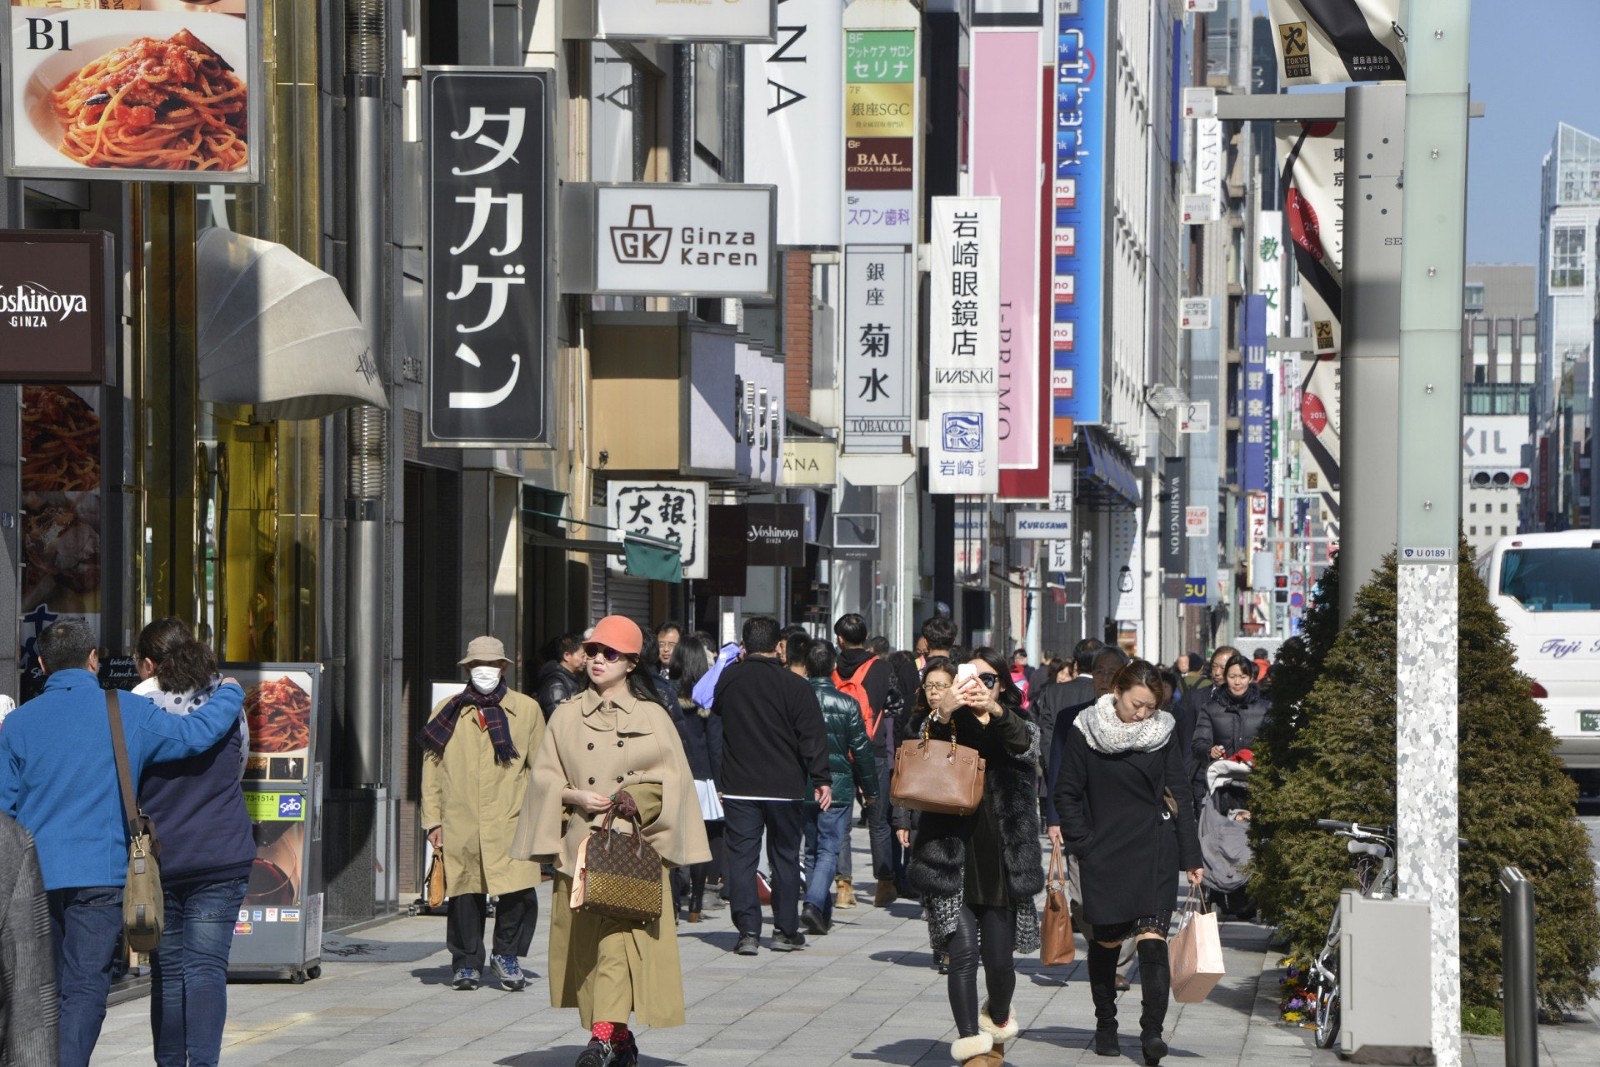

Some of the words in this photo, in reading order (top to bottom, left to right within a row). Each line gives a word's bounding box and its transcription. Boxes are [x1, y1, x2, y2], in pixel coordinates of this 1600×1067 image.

[26, 18, 72, 51] B1
[848, 33, 864, 43] 8F
[766, 0, 807, 117] NA
[848, 46, 887, 58] フットケア
[890, 46, 914, 57] サロン
[1286, 56, 1309, 65] TOKYO
[853, 61, 908, 78] セリナ
[849, 86, 861, 94] 7F
[851, 102, 910, 116] 銀座SGC
[848, 140, 860, 148] 6F
[857, 153, 902, 166] BAAL
[847, 197, 860, 205] 5F
[848, 208, 910, 225] スワン歯科
[682, 227, 755, 245] Ginza
[620, 233, 662, 258] GK
[446, 107, 526, 409] タカゲン
[681, 248, 757, 266] Karen
[866, 262, 885, 306] 銀座
[952, 212, 979, 356] 岩崎眼鏡店
[0, 284, 87, 322] oshinoya
[10, 316, 47, 328] GINZA
[858, 323, 891, 403] 菊水
[852, 418, 904, 434] TOBACCO
[1170, 476, 1180, 555] WASHINGTON
[747, 525, 799, 542] Yoshinoya
[1425, 549, 1446, 557] 0189
[1540, 638, 1582, 659] Fuji
[244, 794, 275, 802] 73-1514
